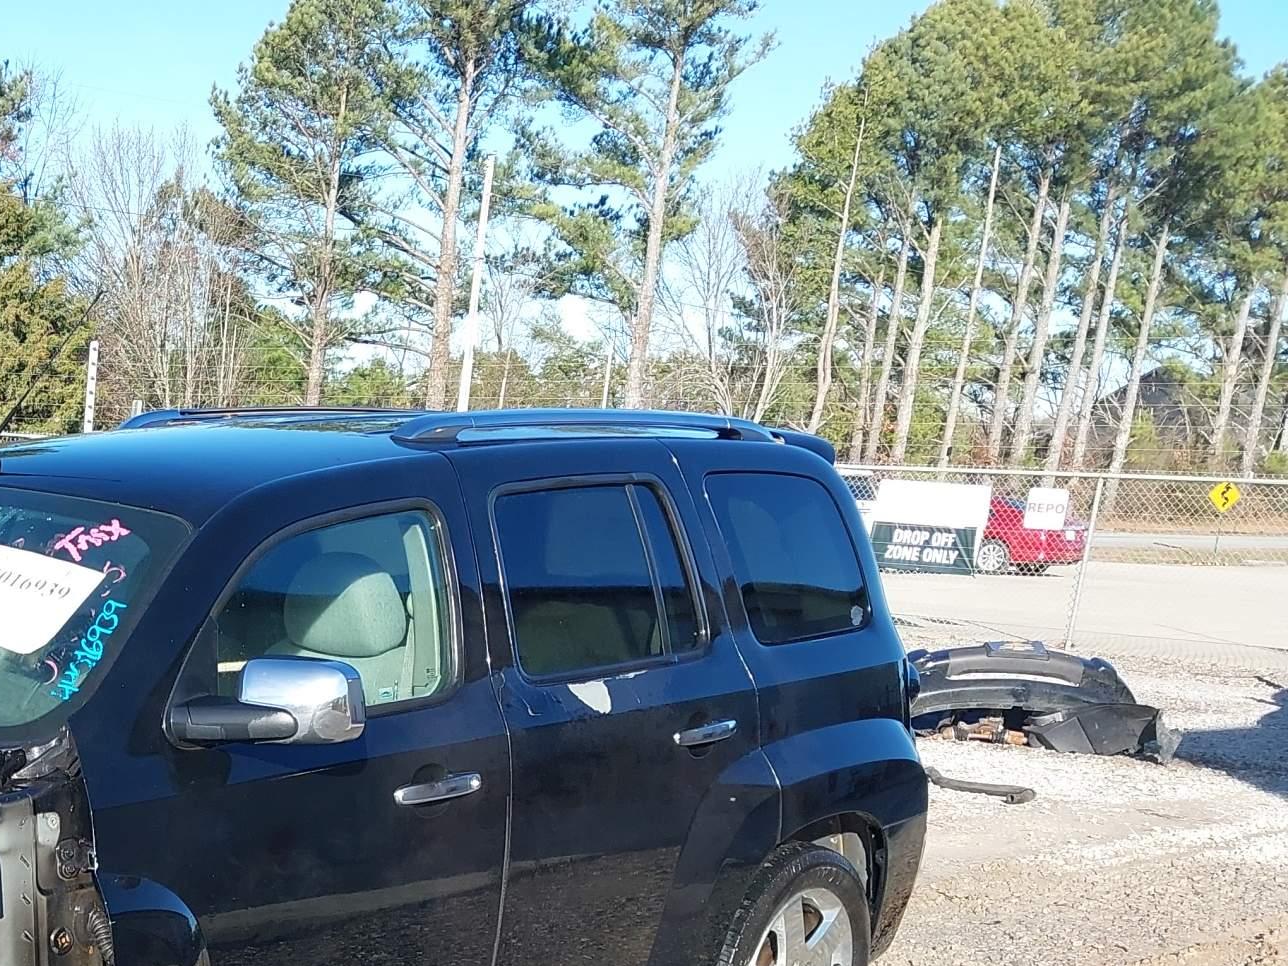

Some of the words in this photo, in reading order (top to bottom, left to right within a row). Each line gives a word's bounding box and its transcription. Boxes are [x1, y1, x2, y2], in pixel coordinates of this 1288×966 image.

[1028, 502, 1065, 514] REPO
[892, 528, 930, 545] DROP
[932, 531, 957, 547] OFF
[884, 544, 921, 561] ZONE
[922, 547, 959, 564] ONLY
